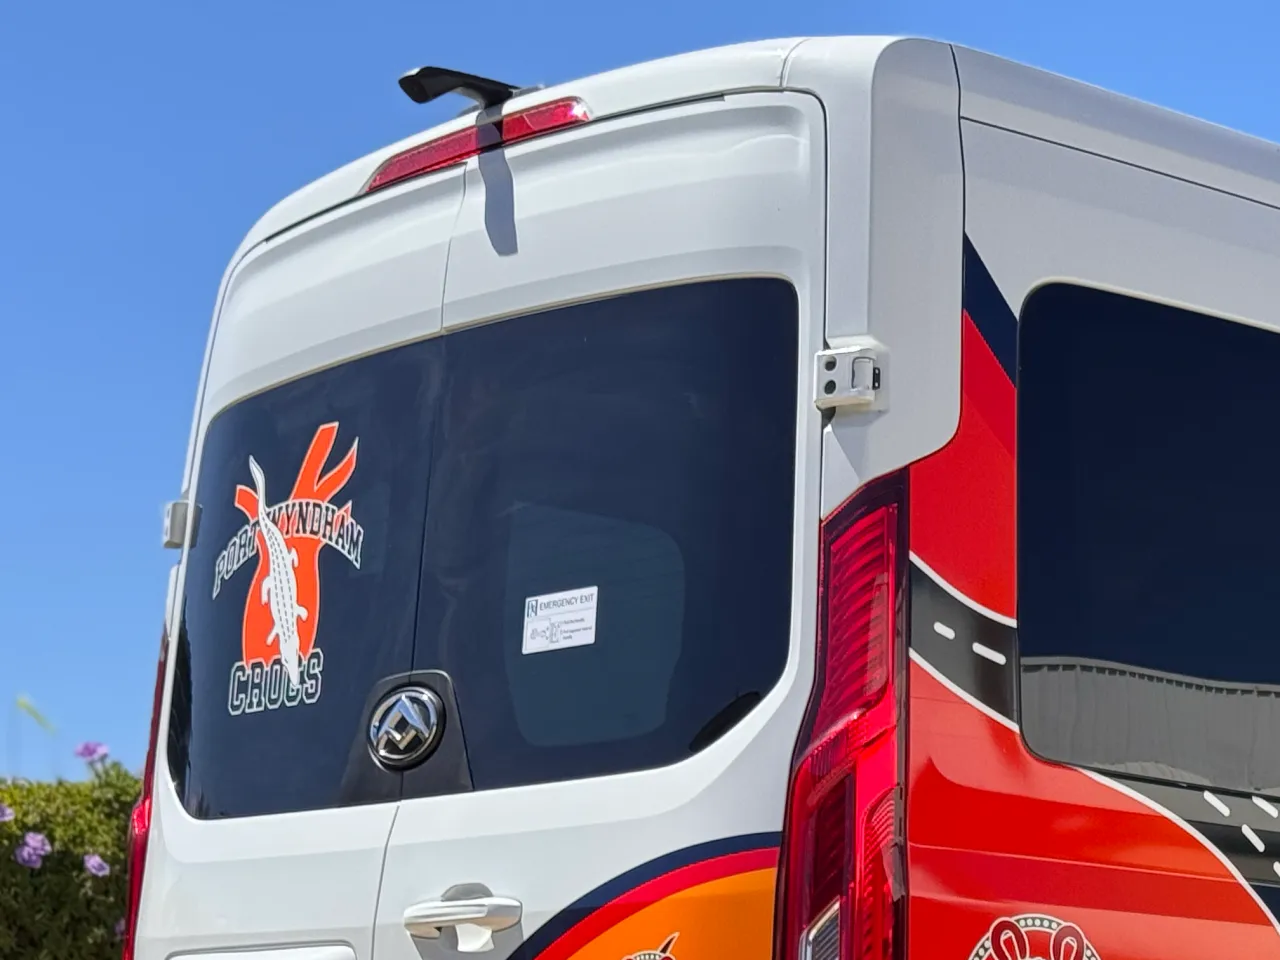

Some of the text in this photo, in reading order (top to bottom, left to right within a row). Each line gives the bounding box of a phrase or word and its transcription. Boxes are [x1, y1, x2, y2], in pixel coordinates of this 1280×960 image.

[211, 499, 364, 600] PORT WYNDHAM
[540, 593, 594, 611] EMERGENCY EXIT
[228, 648, 324, 716] CROCS
